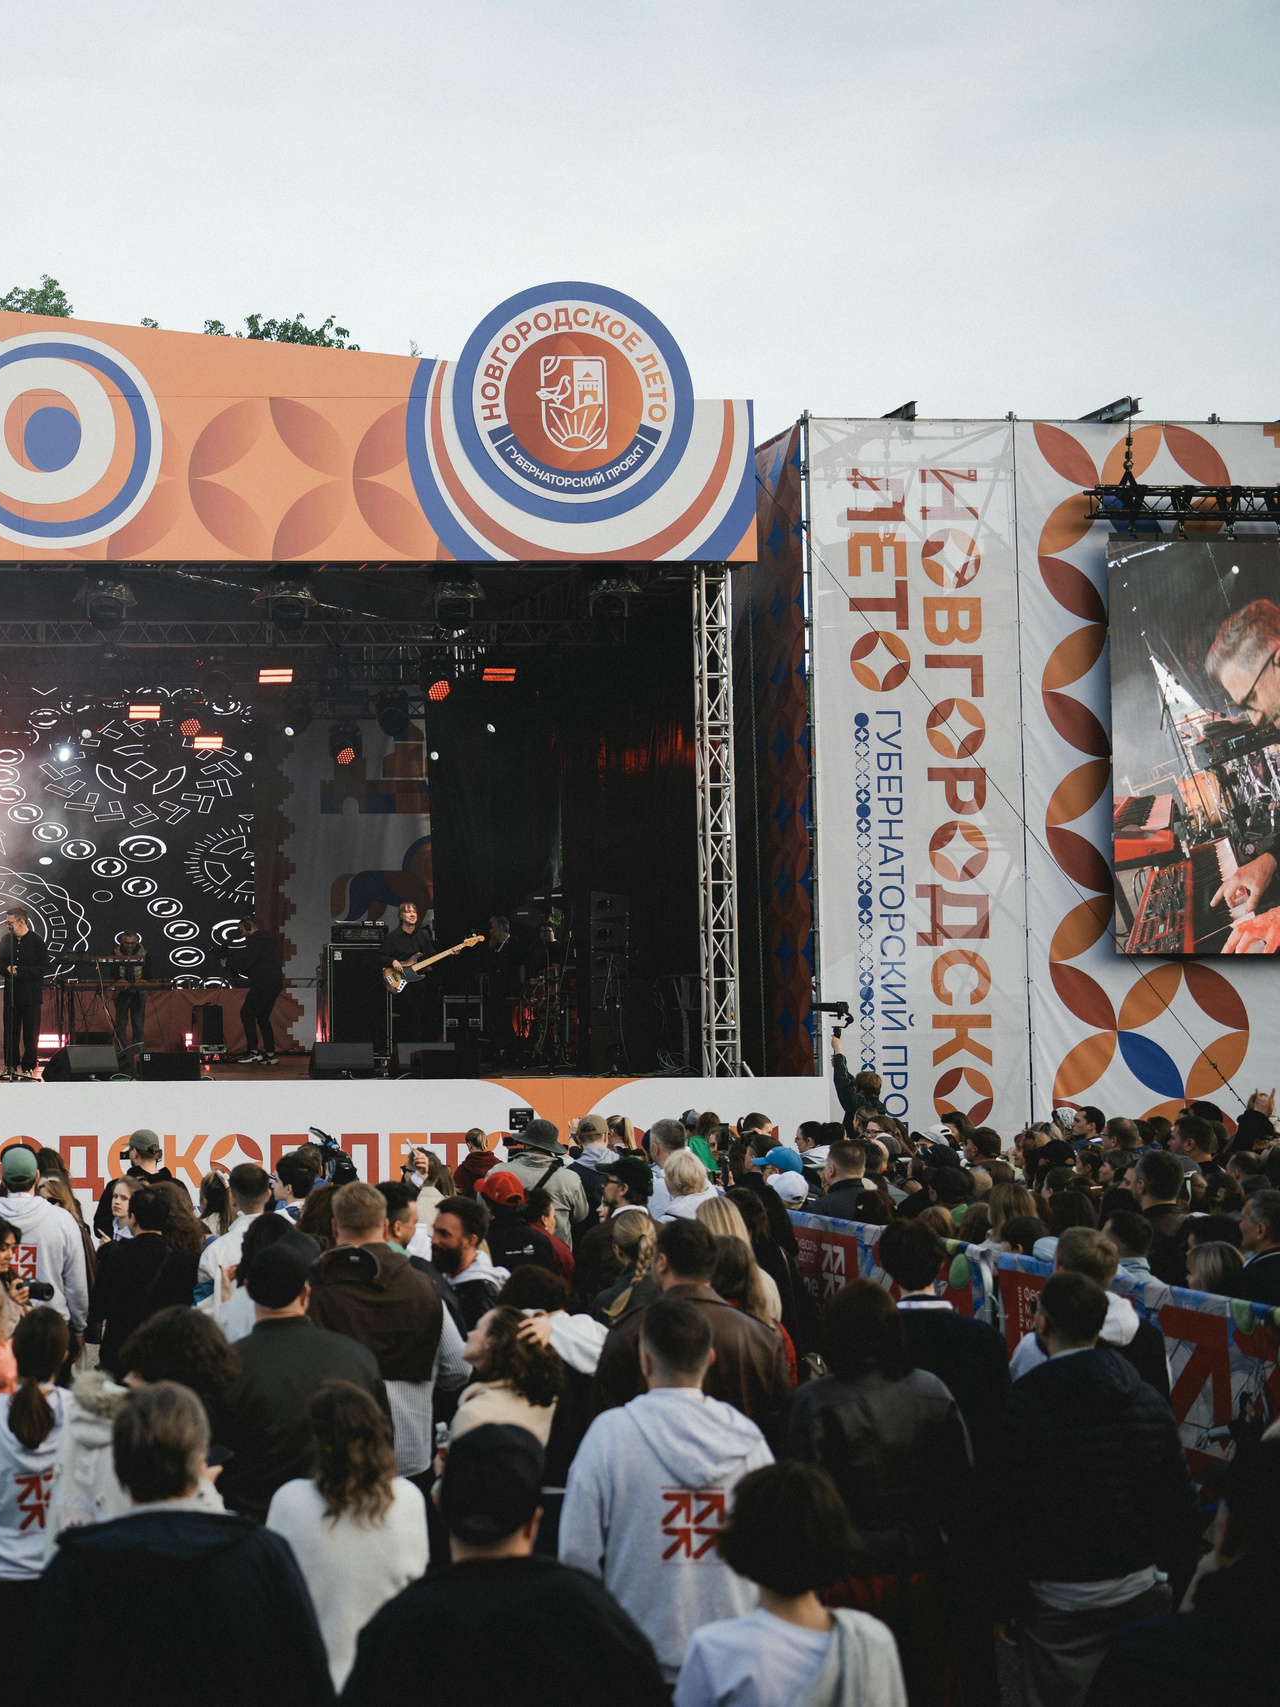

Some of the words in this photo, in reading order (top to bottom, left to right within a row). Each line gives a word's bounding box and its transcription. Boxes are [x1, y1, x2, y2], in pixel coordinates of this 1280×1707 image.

[481, 308, 643, 422] НОВГОРОДСКОЕ
[636, 353, 667, 423] ЛЕТО
[505, 444, 605, 488] ГУБЕРНАТОРСКИЙ
[605, 444, 645, 481] ПРОЕКТ
[845, 468, 911, 692] ЛЕТО
[875, 710, 915, 1031] ГУБЕРНАТОРСКИЙ
[915, 469, 993, 1127] НОВГОРОДСКО
[882, 1045, 909, 1131] ПРО
